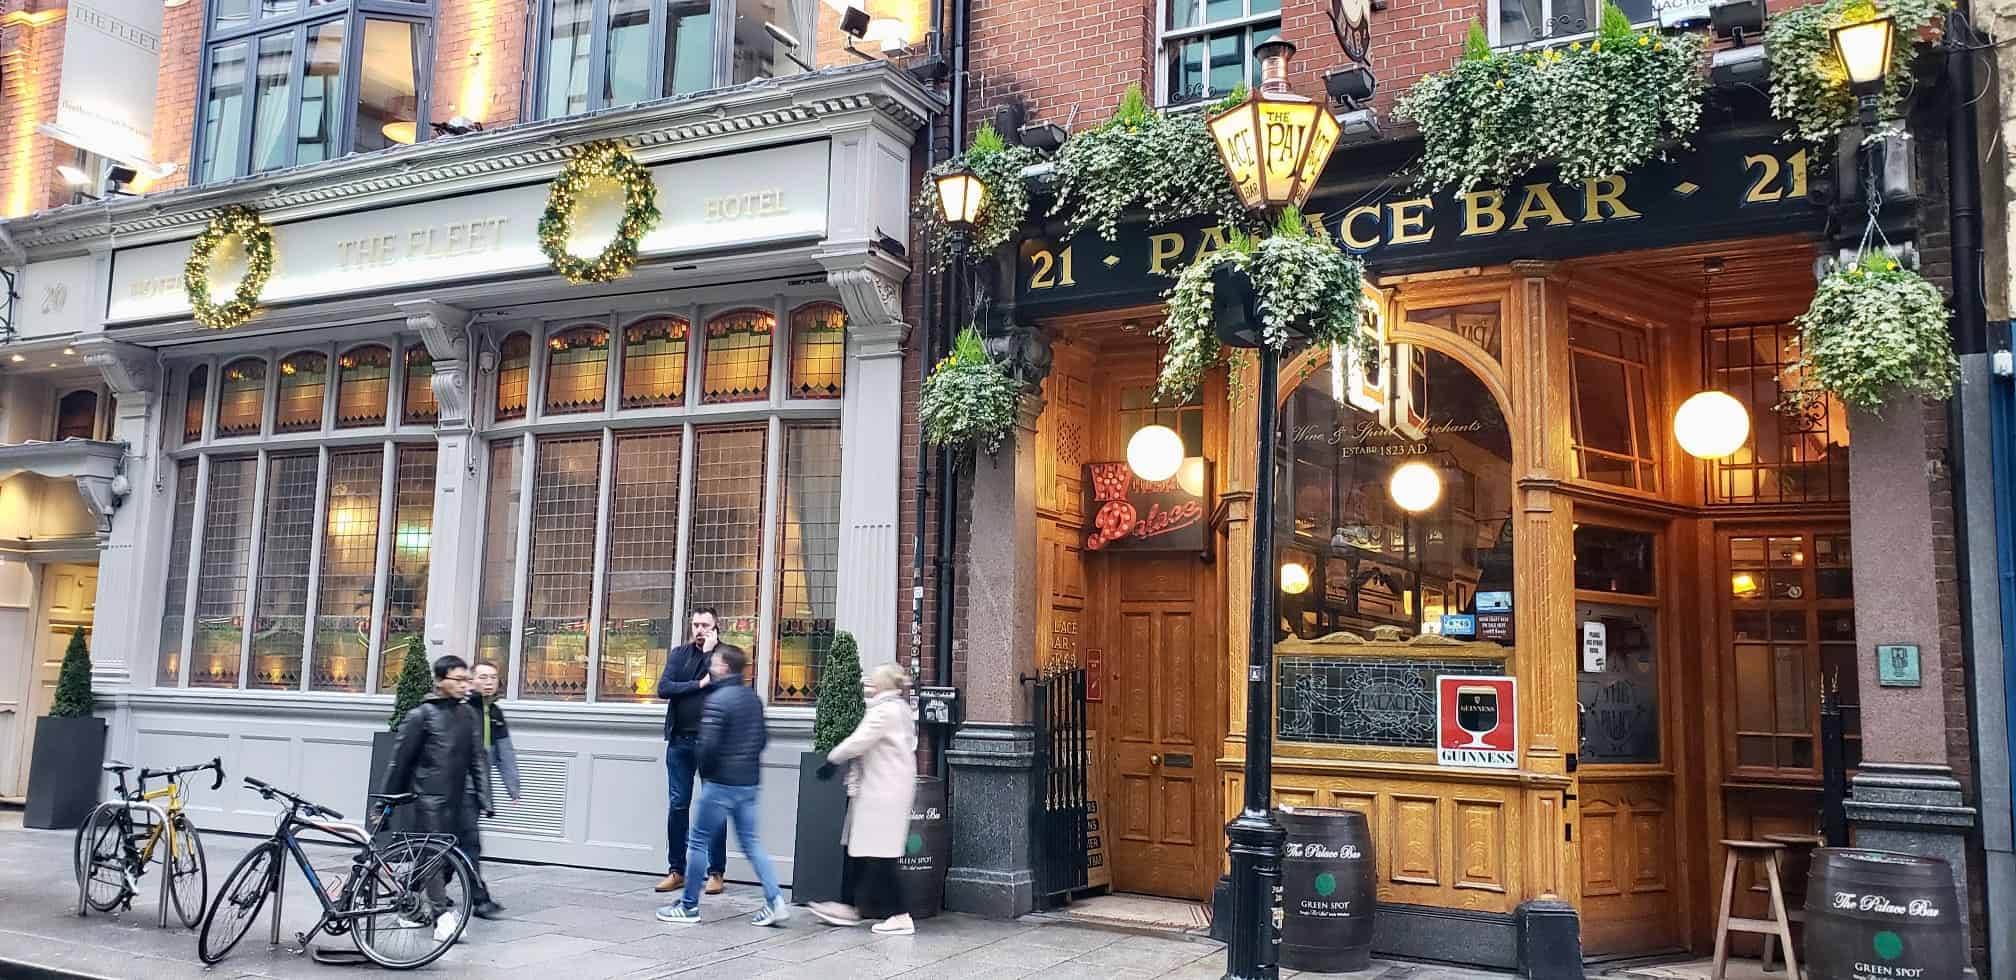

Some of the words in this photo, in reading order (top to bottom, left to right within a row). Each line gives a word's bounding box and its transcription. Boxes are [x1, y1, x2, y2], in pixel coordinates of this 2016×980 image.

[75, 6, 105, 29] THE
[110, 21, 159, 50] FLEET
[1267, 111, 1290, 122] THE
[1244, 182, 1259, 200] BAR
[703, 188, 790, 222] HOTEL
[1030, 245, 1077, 290] 21
[1460, 175, 1644, 239] BAR
[1743, 148, 1809, 203] 21
[336, 231, 399, 271] THE
[407, 216, 513, 257] FLEET
[1292, 424, 1323, 443] Wine
[1380, 444, 1405, 456] 1823
[1406, 443, 1428, 456] AD
[1087, 500, 1202, 550] Palace
[1459, 705, 1497, 713] GUINNESS
[1441, 751, 1516, 765] GUINNESS
[1285, 842, 1304, 858] The
[1304, 843, 1339, 859] Palace
[1340, 844, 1361, 859] Bar
[1300, 899, 1329, 910] GREEN
[1330, 901, 1351, 910] SPOT
[1832, 891, 1857, 910] The
[1859, 894, 1907, 916] Palace
[1908, 898, 1940, 918] Bar
[1854, 962, 1893, 976] GREEN
[1895, 967, 1922, 978] SPOT
